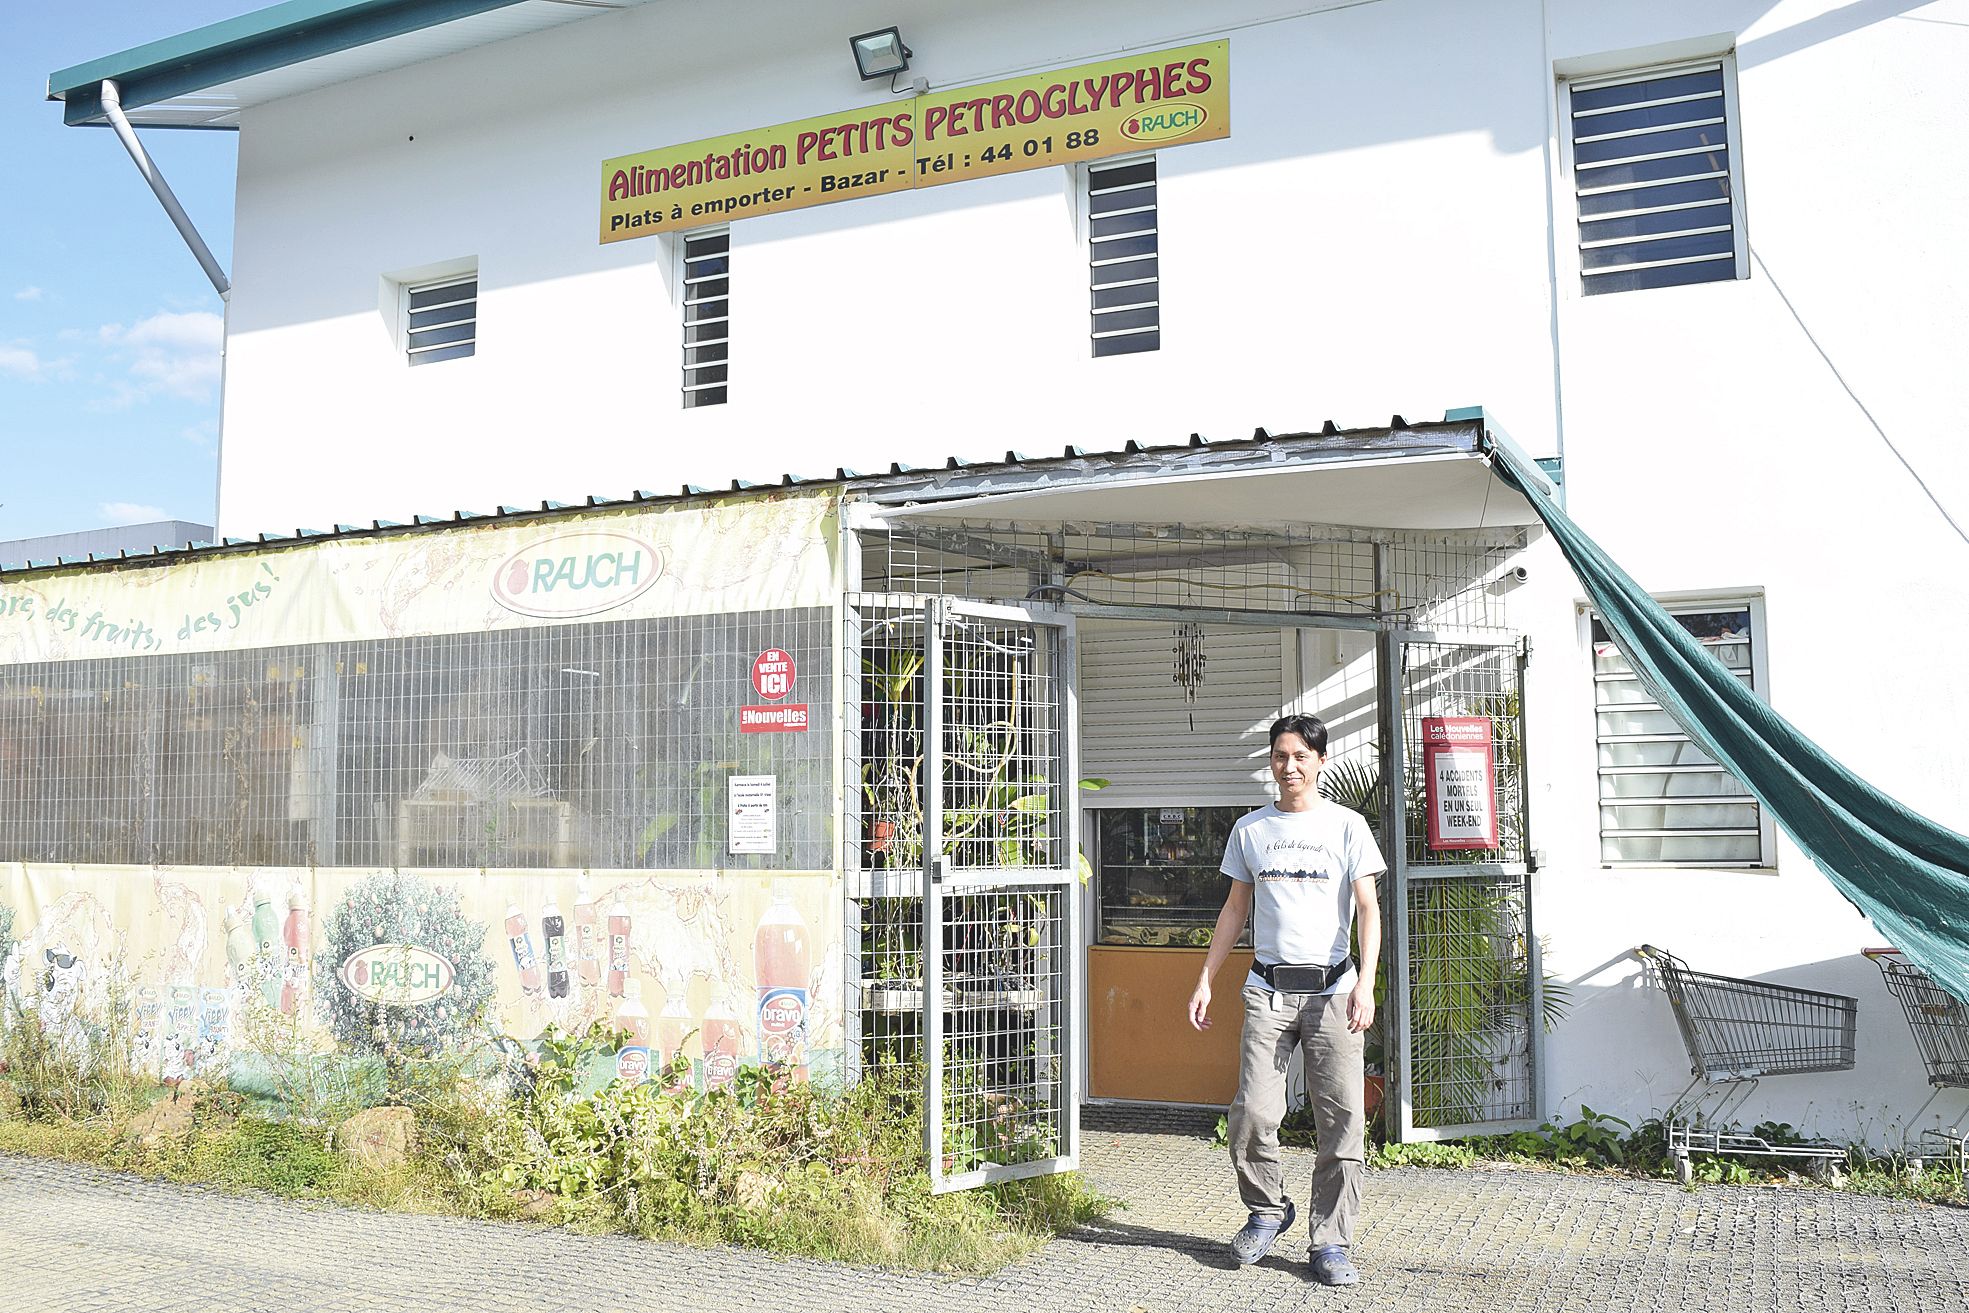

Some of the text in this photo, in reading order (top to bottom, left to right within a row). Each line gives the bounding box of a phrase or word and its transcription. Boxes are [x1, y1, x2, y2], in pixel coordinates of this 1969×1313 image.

[1142, 108, 1198, 133] RAUCH
[608, 58, 1212, 201] Alimentation PETITS PETROGLYPHES
[611, 210, 663, 231] Plats
[671, 204, 683, 220] à
[691, 186, 795, 216] emporter
[821, 169, 889, 193] Bazar
[916, 152, 954, 175] Tél
[981, 143, 1013, 163] 44
[1023, 136, 1053, 156] 01
[1066, 128, 1100, 150] 88
[531, 550, 641, 594] RAUCH
[46, 597, 79, 632] des
[80, 611, 162, 650] fruits,
[177, 611, 222, 641] des
[767, 651, 780, 661] EN
[758, 661, 788, 674] VENTE
[760, 673, 787, 694] ICI
[747, 708, 807, 724] Nouvelles
[1430, 724, 1483, 733] Les Nouvelles
[1431, 732, 1484, 740] calédoniennes
[1440, 770, 1483, 781] 4 ACCIDENTS
[1446, 785, 1478, 797] MORTELS
[1444, 800, 1483, 812] EN UN SEUL
[1446, 815, 1482, 827] WEEK-END
[371, 960, 440, 989] RAUCH
[763, 1008, 800, 1022] bravo
[620, 1060, 645, 1070] bravo
[707, 1064, 735, 1076] bravo
